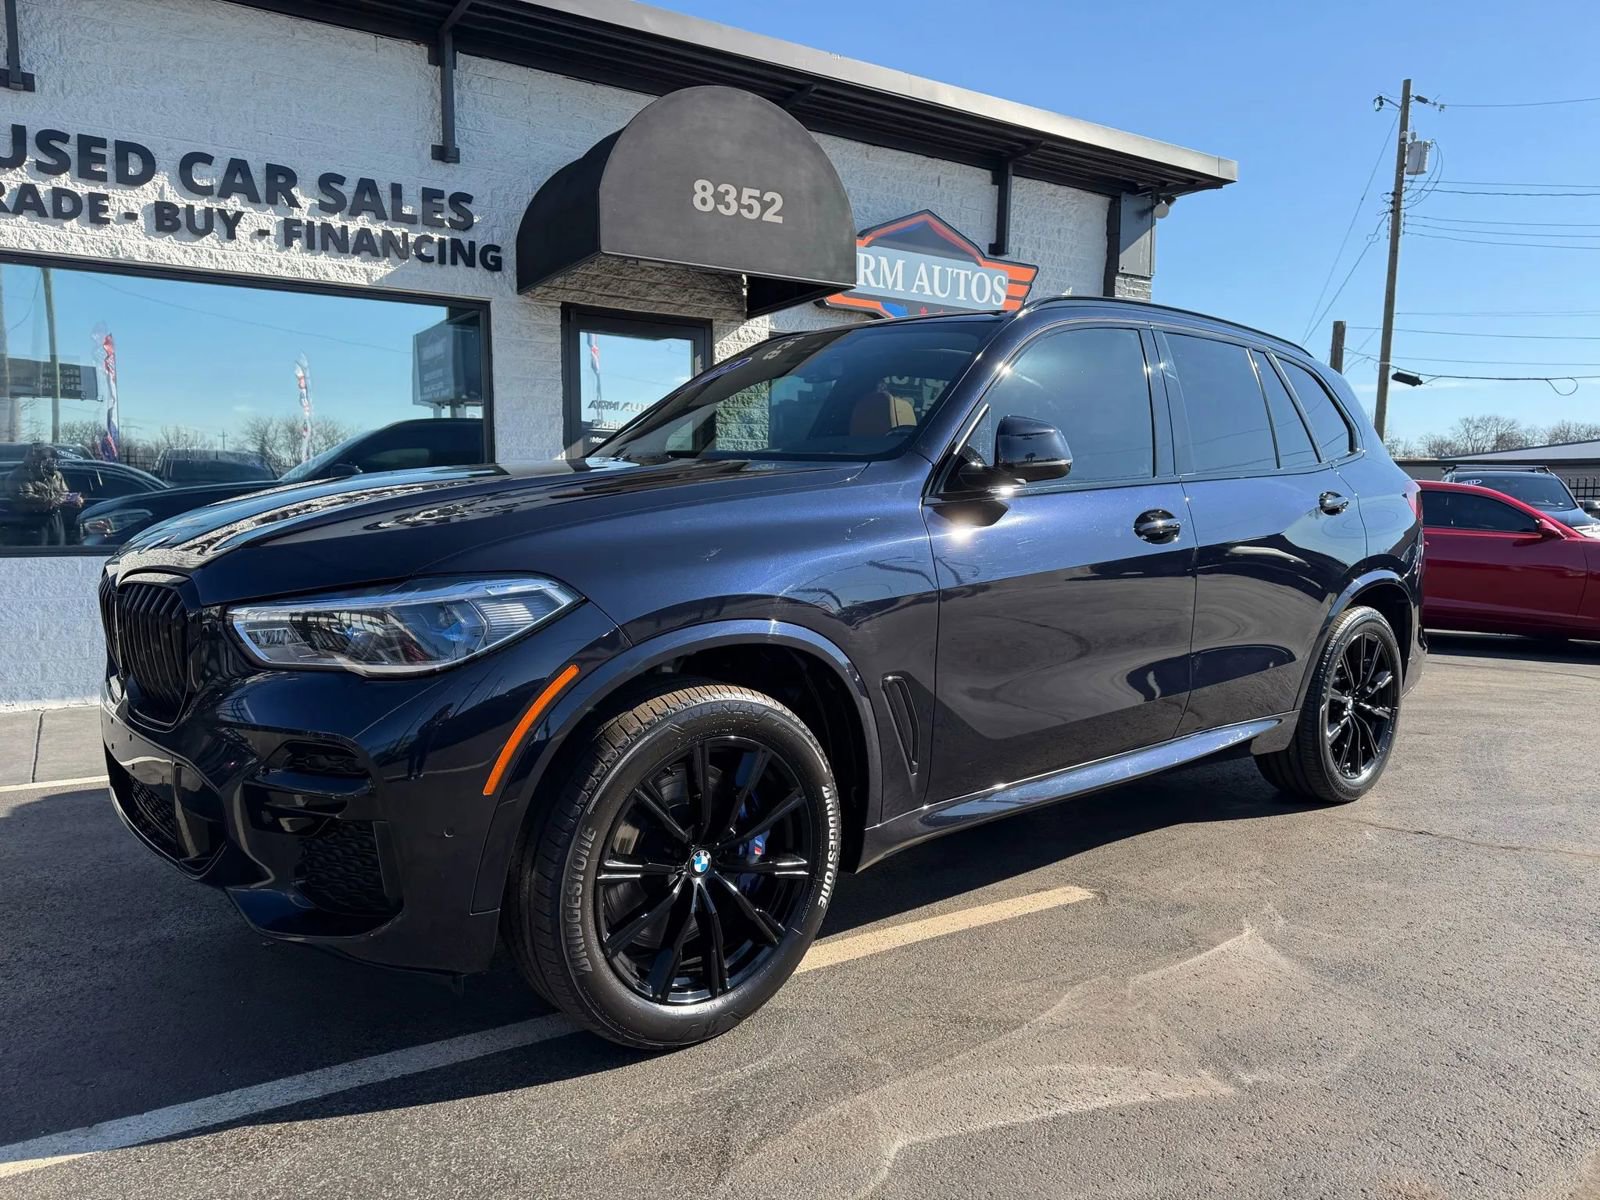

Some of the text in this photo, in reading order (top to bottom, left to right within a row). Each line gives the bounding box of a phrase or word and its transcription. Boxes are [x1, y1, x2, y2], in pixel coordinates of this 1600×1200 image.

[0, 124, 475, 231] USED CAR SALES
[692, 179, 784, 224] 8352
[154, 200, 245, 241] BUY
[284, 217, 503, 272] FINANCING
[856, 252, 1007, 306] RM AUTOS
[818, 783, 839, 910] BRIDGESTONE
[566, 825, 597, 977] BRIDGESTONE
